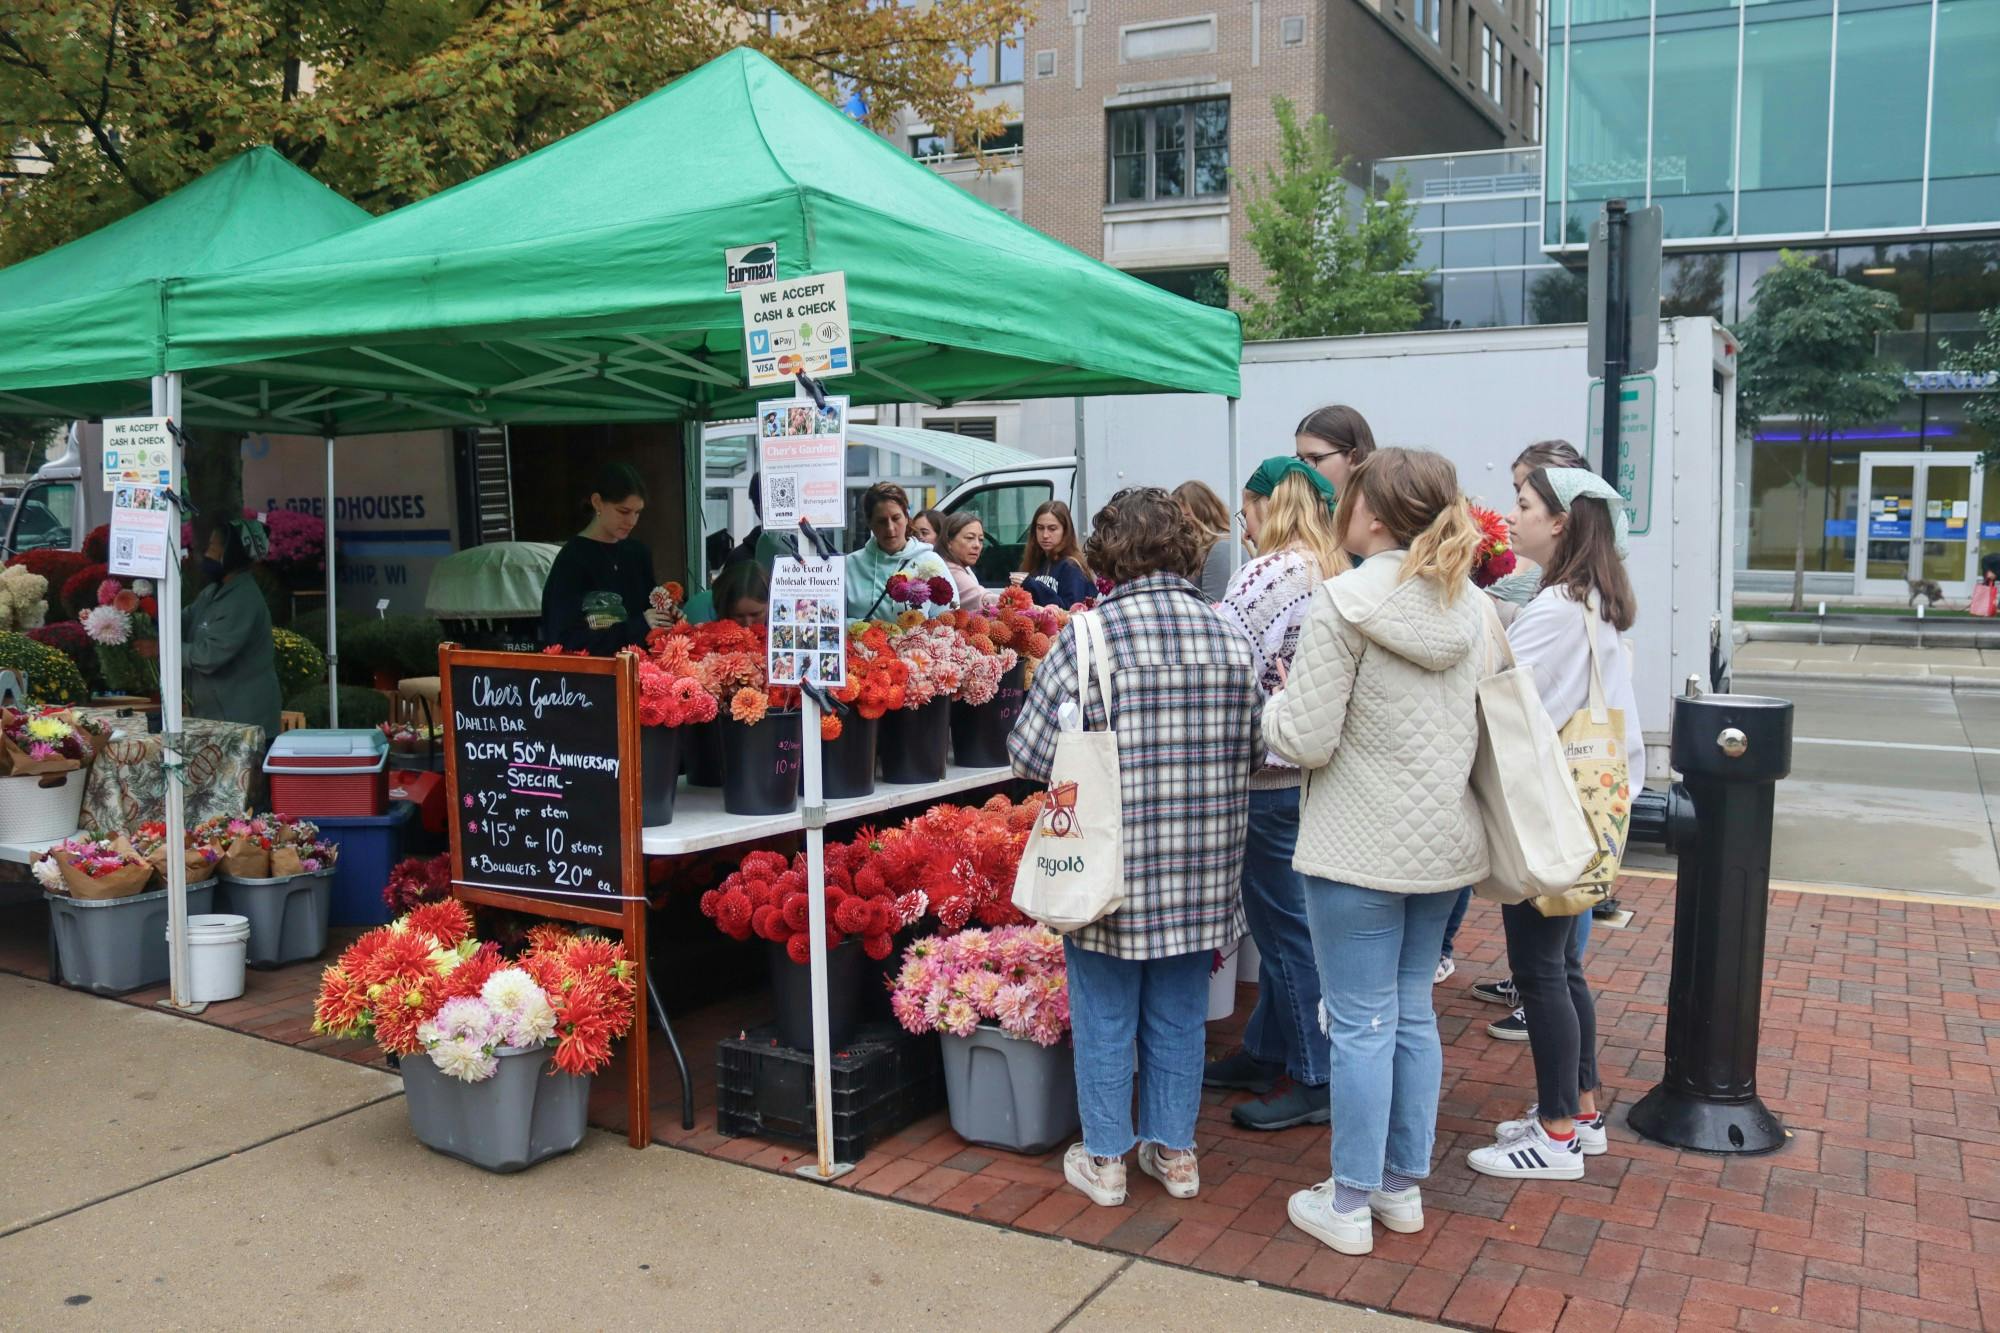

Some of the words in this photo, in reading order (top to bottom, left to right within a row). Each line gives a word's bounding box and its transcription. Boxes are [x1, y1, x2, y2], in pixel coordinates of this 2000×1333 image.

[728, 263, 773, 283] Eurmax
[760, 292, 777, 304] WE
[782, 284, 825, 301] ACCEPT
[754, 309, 783, 323] CASH
[786, 307, 794, 318] &
[798, 300, 837, 317] CHECK
[779, 337, 793, 347] Pay
[756, 363, 774, 374] VISA
[115, 424, 126, 433] WE
[129, 423, 159, 432] ACCEPT
[110, 437, 129, 446] CASH
[130, 437, 136, 446] &
[138, 436, 165, 445] CHECK
[767, 445, 798, 457] Cher's
[800, 443, 836, 456] Garden
[286, 495, 425, 520] GRENHOUSES
[792, 564, 801, 573] do
[802, 564, 823, 574] Event
[775, 576, 807, 586] Wholesale
[808, 576, 841, 586] Flowers!
[530, 676, 593, 718] Garden
[456, 711, 497, 732] DAHLIA
[501, 715, 527, 732] BAR
[465, 742, 508, 761] DCFM
[512, 741, 545, 764] 50th
[548, 744, 620, 779] ANNIVERSARY
[515, 807, 530, 820] per
[541, 804, 569, 820] stem
[525, 836, 539, 849] for
[546, 827, 564, 854] 10
[571, 842, 603, 856] stems
[598, 880, 616, 894] ea.
